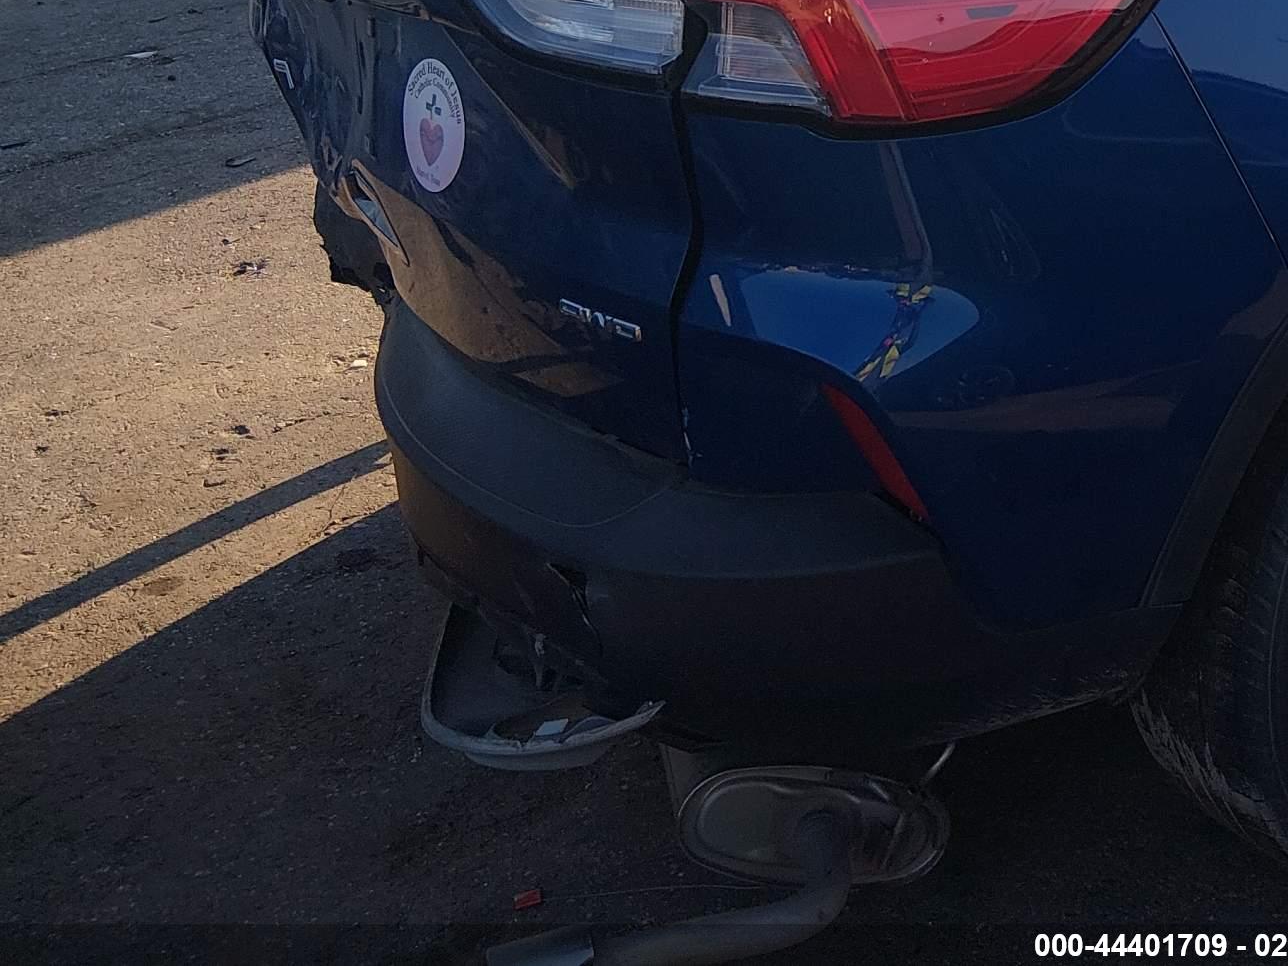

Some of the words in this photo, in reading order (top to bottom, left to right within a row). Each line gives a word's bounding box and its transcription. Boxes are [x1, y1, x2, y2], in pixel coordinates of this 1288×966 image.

[407, 62, 427, 96] Sacred
[427, 61, 446, 79] Heart
[445, 77, 454, 90] of
